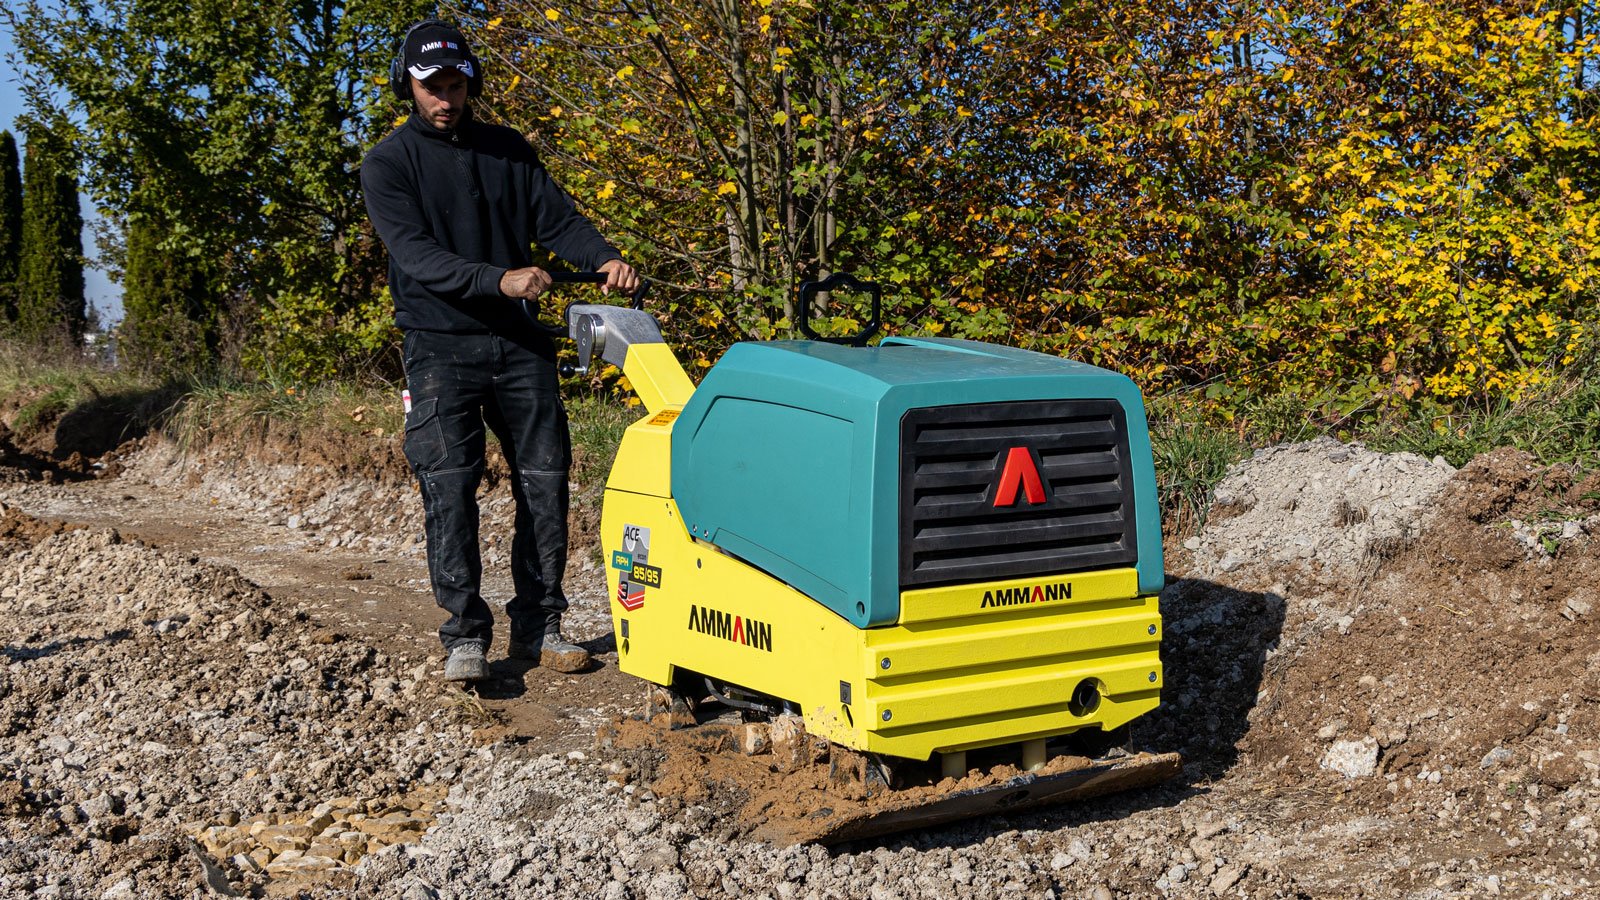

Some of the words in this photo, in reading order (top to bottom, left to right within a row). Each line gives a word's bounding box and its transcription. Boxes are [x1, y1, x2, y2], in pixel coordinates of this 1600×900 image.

[624, 526, 640, 542] ACE
[980, 582, 1072, 608] AMMANN
[688, 604, 772, 652] AMMANN
